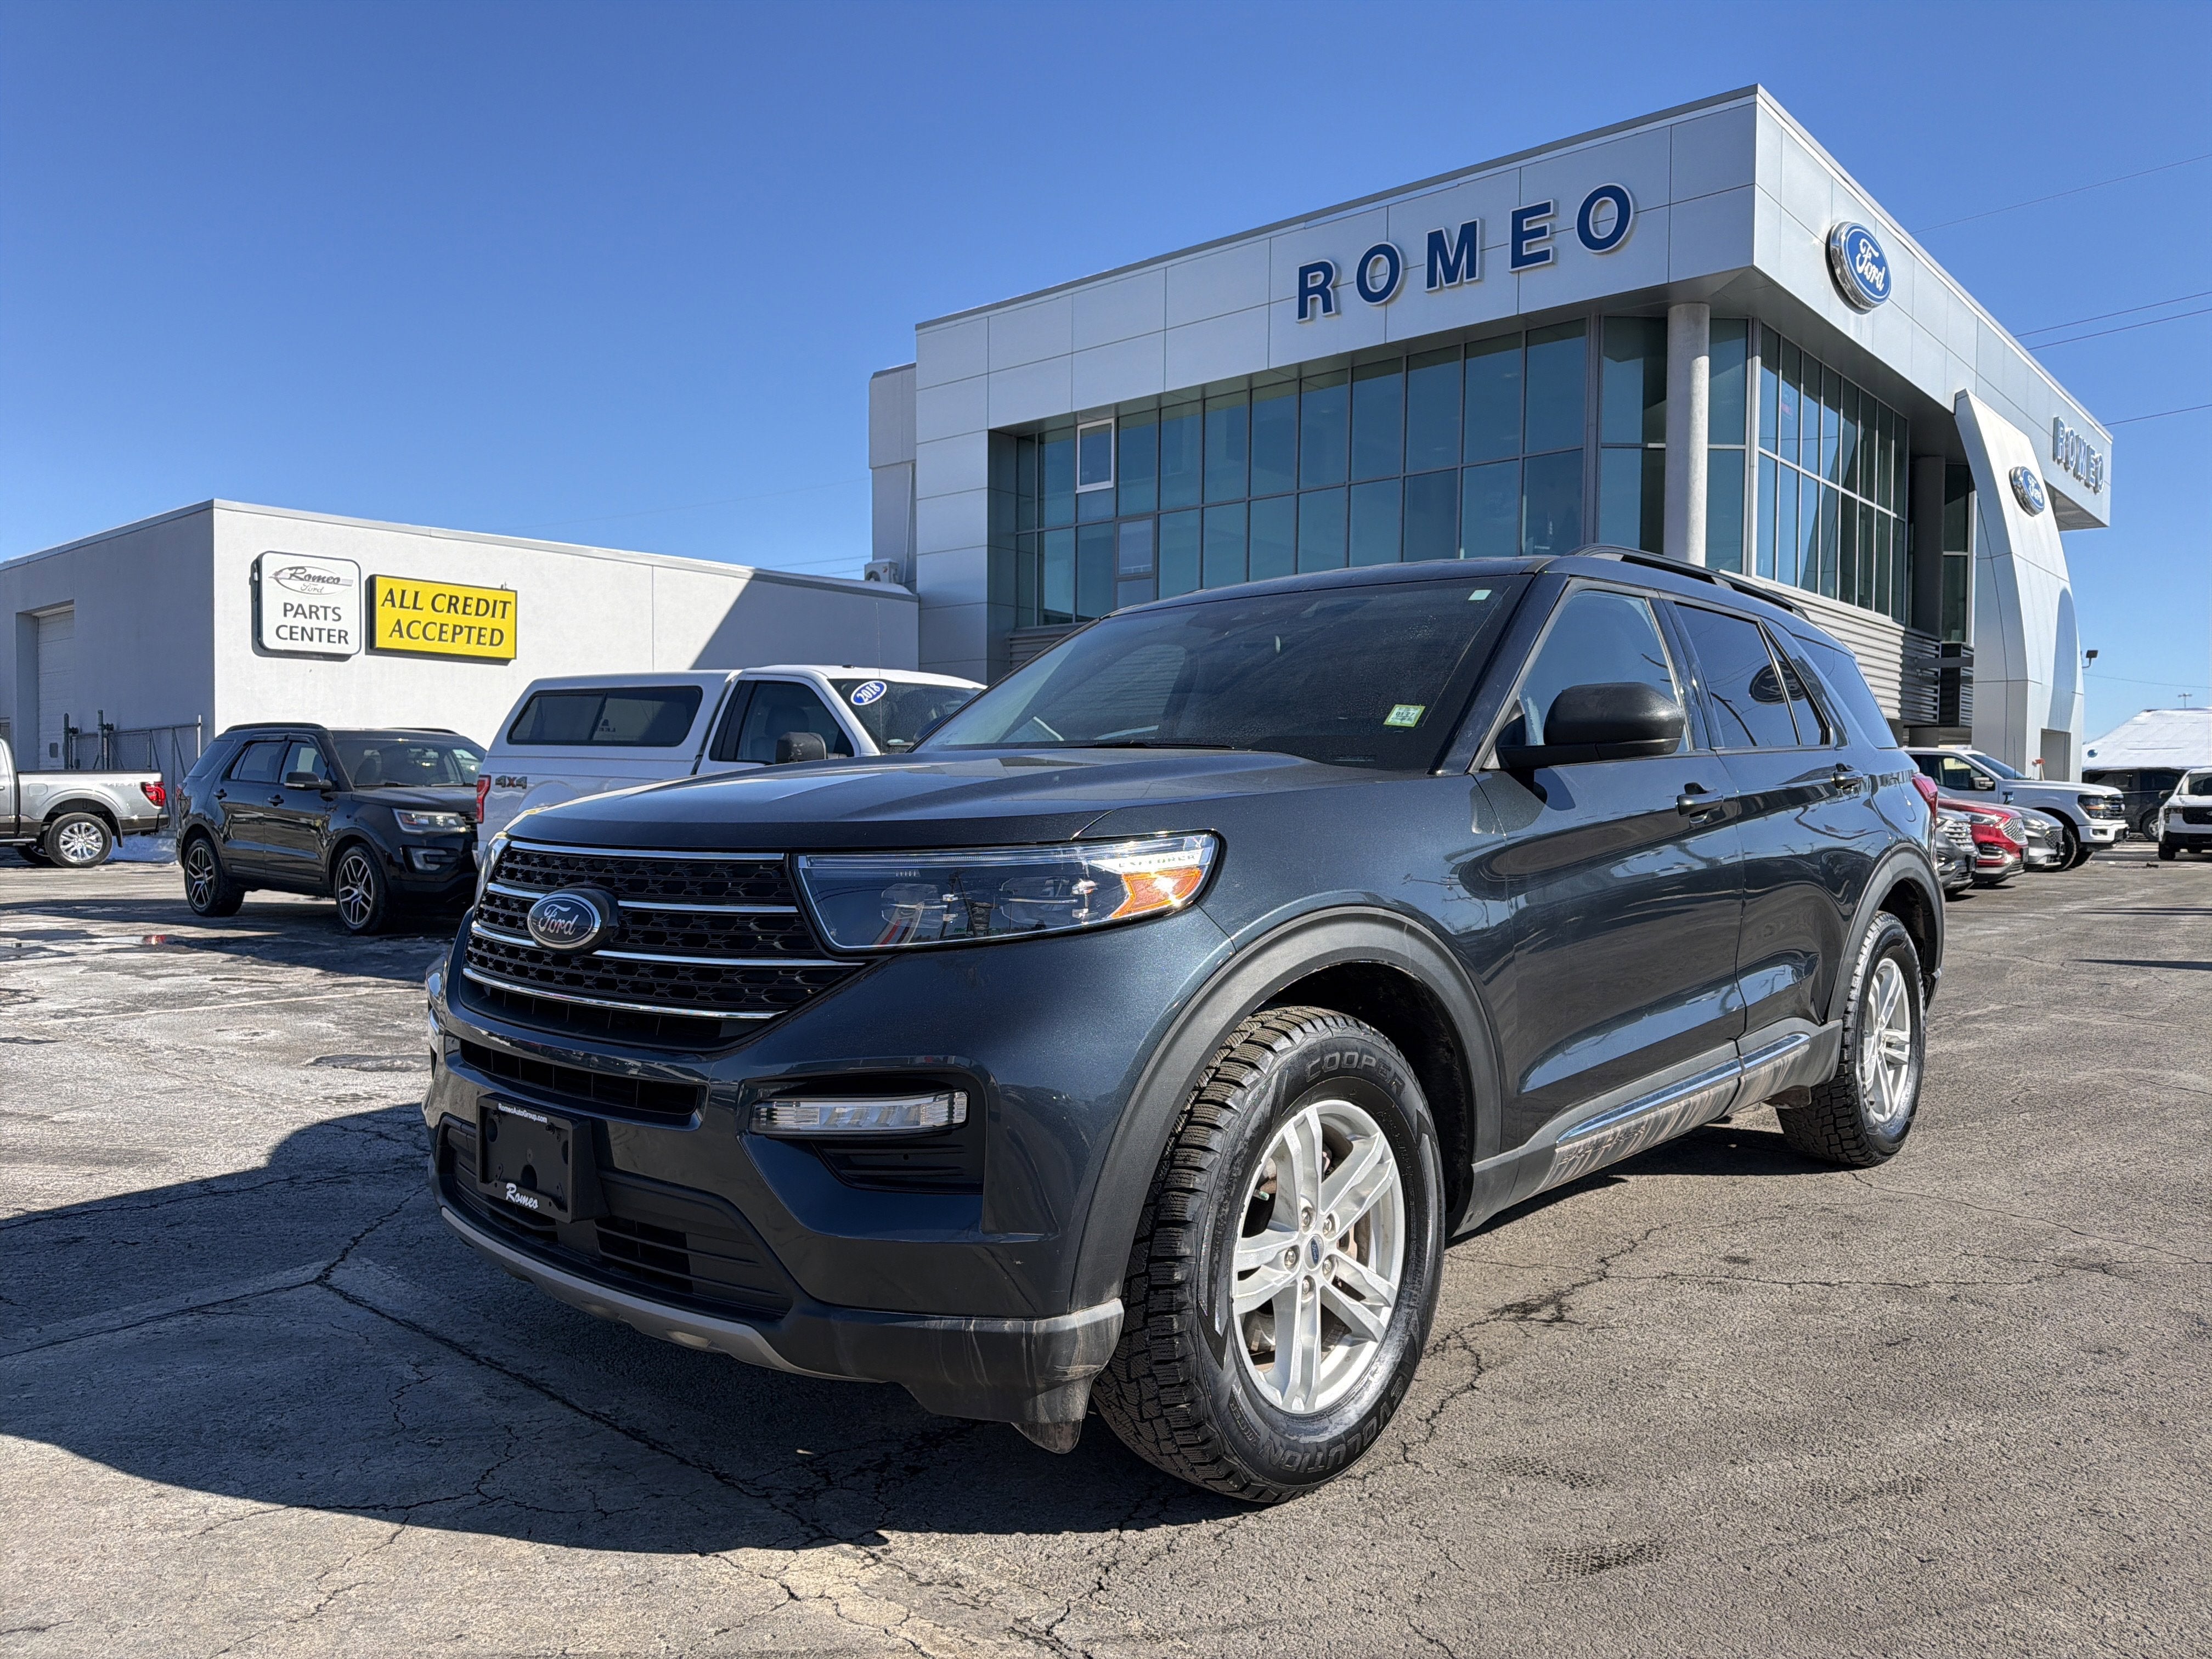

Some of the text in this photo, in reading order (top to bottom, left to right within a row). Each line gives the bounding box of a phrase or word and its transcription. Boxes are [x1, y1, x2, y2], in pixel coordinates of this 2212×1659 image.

[1296, 182, 1634, 323] ROMEO
[1856, 238, 1886, 291] Ford
[2053, 416, 2104, 493] ROMEO
[2028, 475, 2042, 504] Ford
[289, 566, 341, 585] Romeo
[301, 583, 324, 593] Ford
[284, 602, 341, 622] PARTS
[381, 588, 511, 619] ALL CREDIT
[275, 624, 349, 645] CENTER
[389, 618, 504, 647] ACCEPTED
[857, 683, 880, 702] 2018
[538, 904, 579, 935] Ford
[1305, 1051, 1406, 1096] COOPER
[498, 1103, 548, 1124] RomeoAutoGroup.com
[506, 1182, 539, 1209] Romeo
[1259, 1376, 1406, 1474] EVOLUTION
